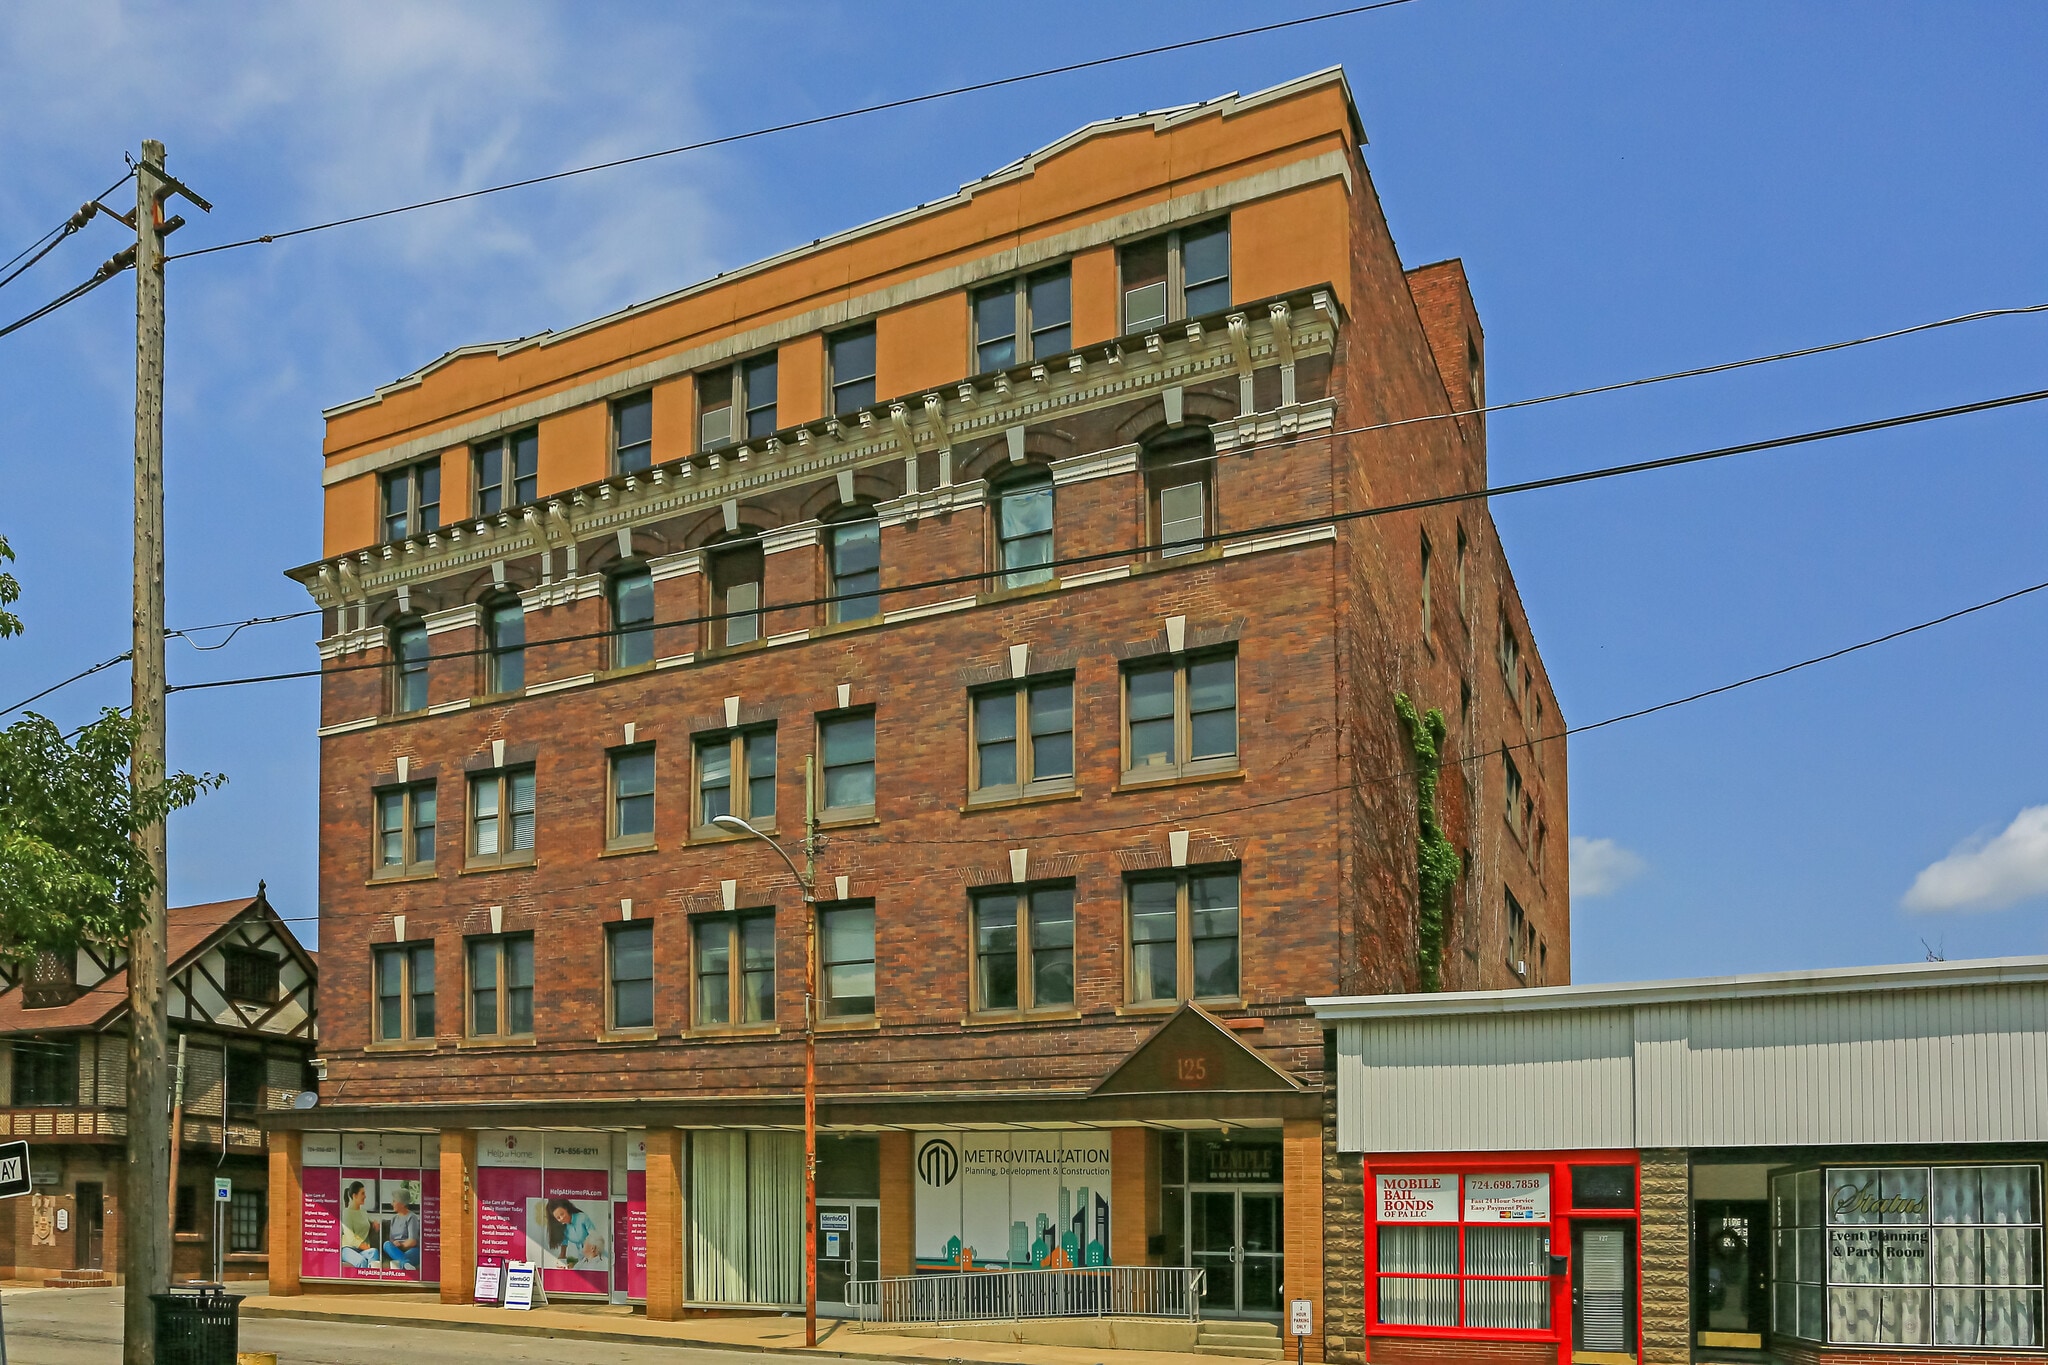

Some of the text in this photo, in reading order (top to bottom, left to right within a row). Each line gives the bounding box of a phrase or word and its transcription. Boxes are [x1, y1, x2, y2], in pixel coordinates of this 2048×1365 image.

[1177, 1058, 1206, 1080] 125
[487, 1149, 504, 1159] Help
[510, 1149, 533, 1159] Home
[964, 1149, 1109, 1163] METROVITALIZATION
[1209, 1150, 1272, 1169] TEMPLE
[965, 1166, 1110, 1176] Planning, Development & Construction
[1384, 1178, 1441, 1189] MOBILE
[1472, 1180, 1540, 1190] 724.698.7858
[1384, 1190, 1416, 1200] BAIL
[1830, 1180, 1928, 1221] Status
[1384, 1200, 1434, 1210] BONDS
[1829, 1230, 1928, 1243] Event Planning
[1833, 1246, 1924, 1259] & Party Room
